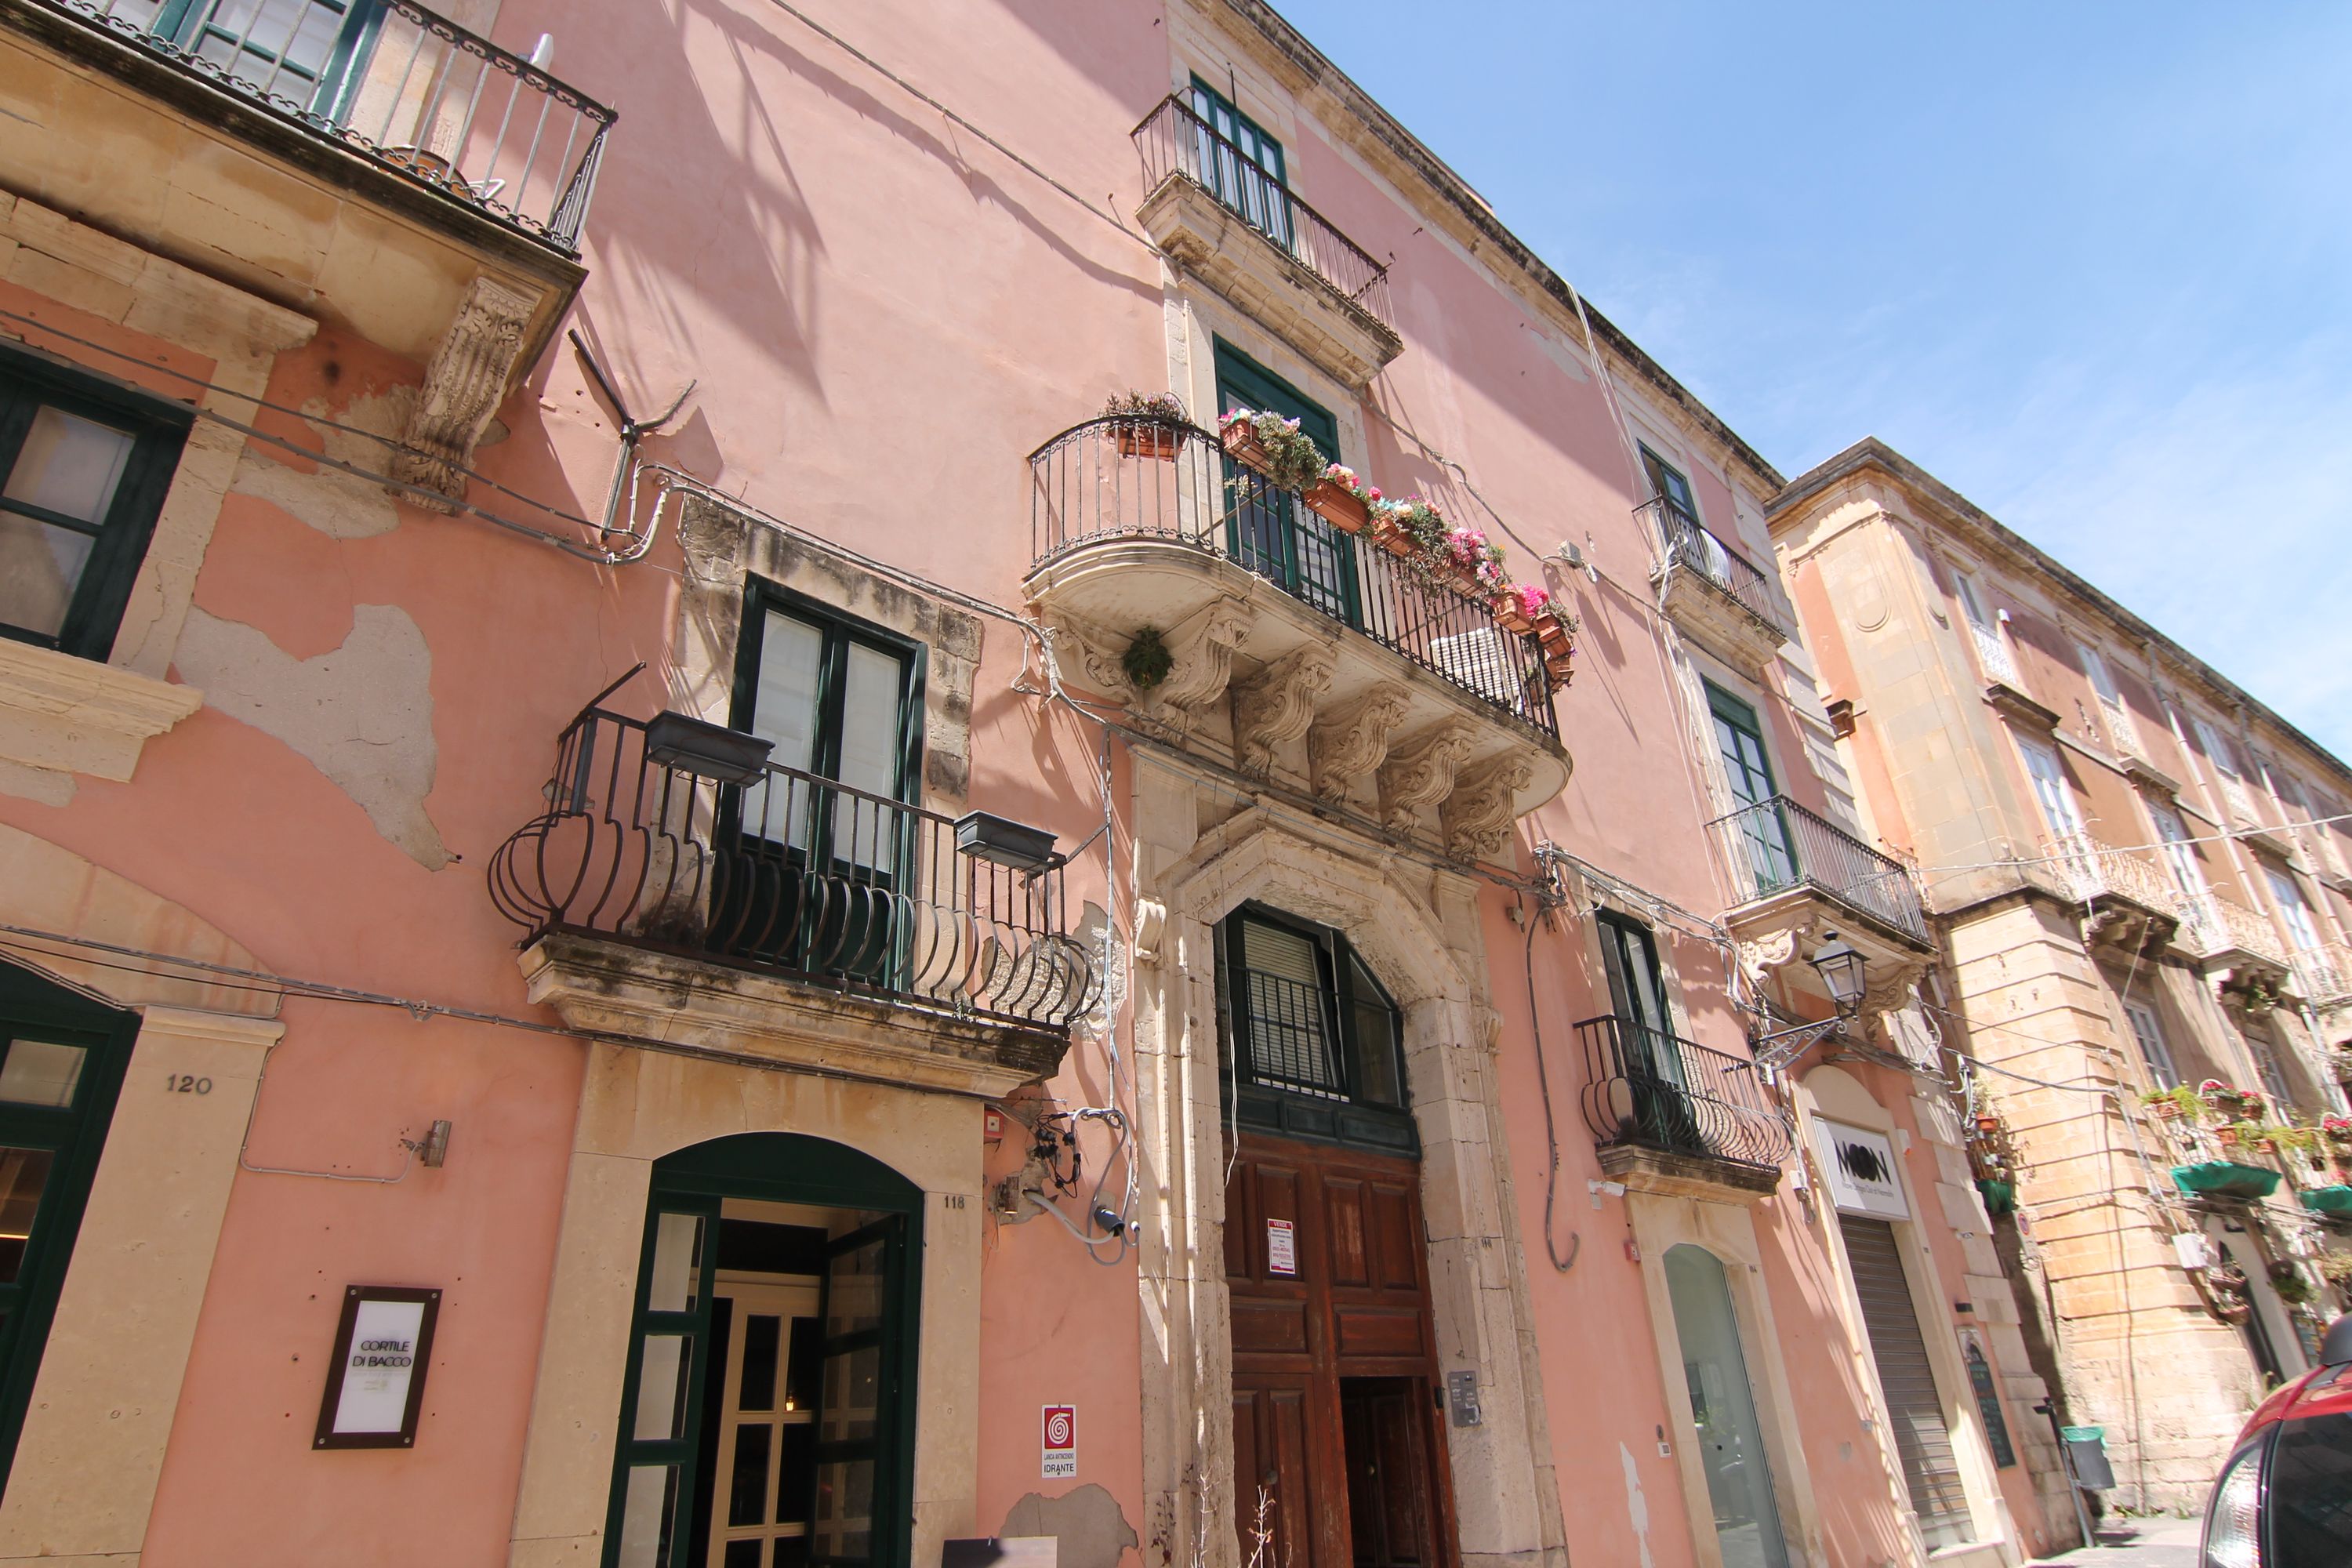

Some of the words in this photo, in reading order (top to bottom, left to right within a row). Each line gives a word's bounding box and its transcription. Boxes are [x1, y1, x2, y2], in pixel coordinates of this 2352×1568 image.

[167, 1073, 212, 1094] 120
[1833, 1137, 1892, 1185] MOON
[945, 1196, 964, 1209] 118
[361, 1341, 410, 1352] CORTILE
[352, 1356, 365, 1367] DI
[368, 1356, 412, 1367] BACCO
[1044, 1463, 1074, 1472] IDRANTE
